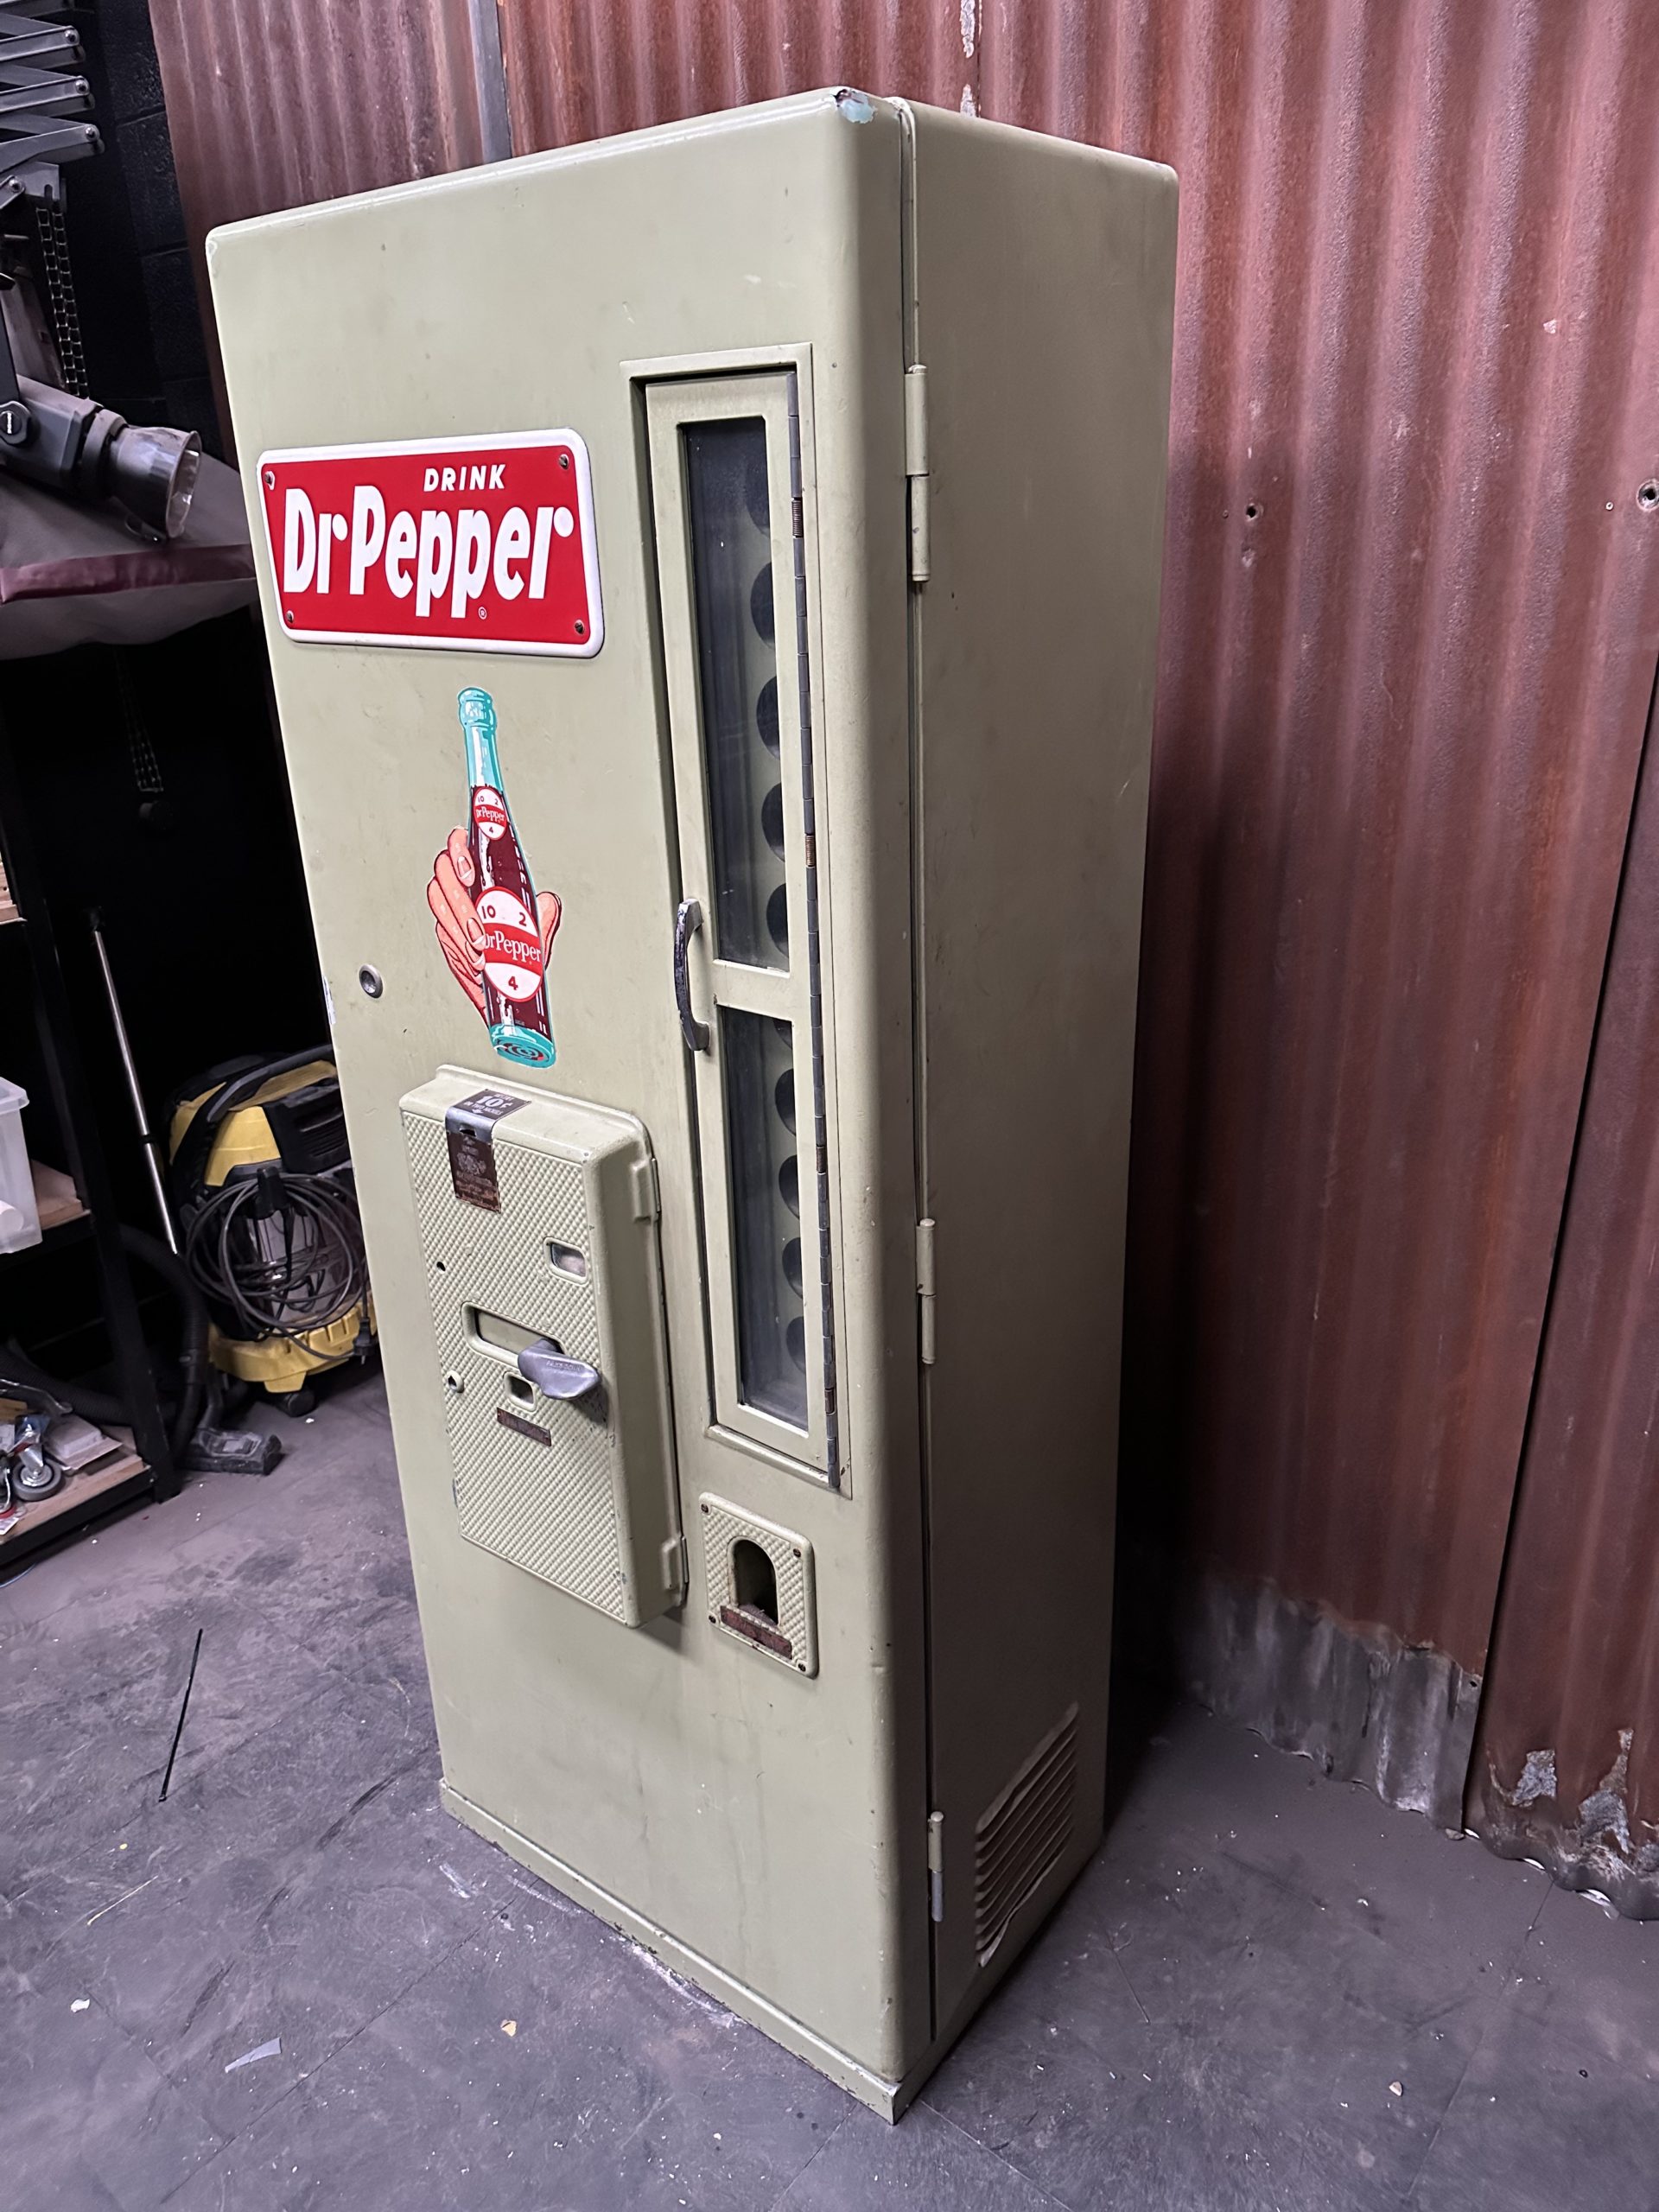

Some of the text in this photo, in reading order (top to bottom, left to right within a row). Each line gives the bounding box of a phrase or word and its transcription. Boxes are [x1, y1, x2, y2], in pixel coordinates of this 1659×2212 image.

[423, 464, 506, 493] DRINK
[481, 905, 527, 926] 10 2
[508, 976, 518, 990] 4
